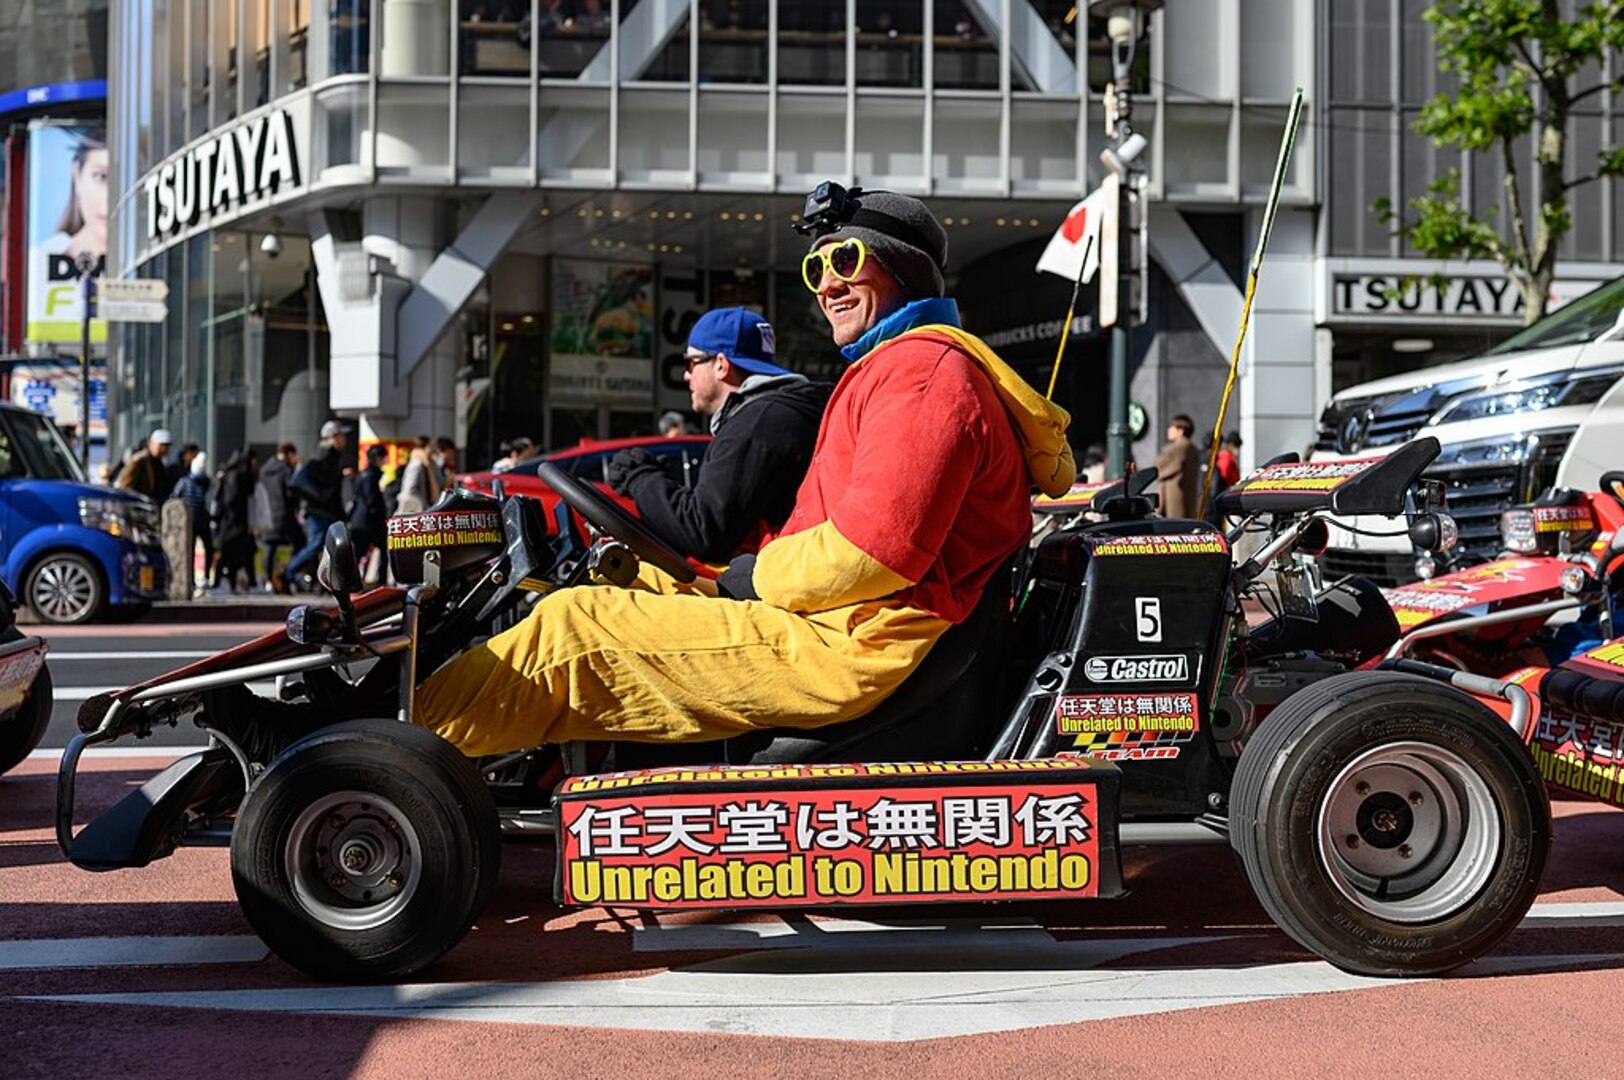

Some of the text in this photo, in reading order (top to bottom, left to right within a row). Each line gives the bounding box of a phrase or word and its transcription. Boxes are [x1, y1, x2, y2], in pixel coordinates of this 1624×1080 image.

[145, 110, 300, 240] TSUTAYA
[388, 533, 442, 549] Unrelated
[443, 532, 455, 546] to
[1096, 541, 1222, 555] Unrelated to Nintendo
[1140, 601, 1158, 637] 5
[1111, 657, 1184, 680] Castrol
[1060, 696, 1193, 716] 任天堂は無関係
[1060, 715, 1194, 733] Unrelated to Nintendo
[570, 768, 801, 792] Unrelated
[866, 760, 1079, 775] Nintendo
[1531, 741, 1616, 799] Unrelated
[567, 795, 1091, 857] 任天堂は無関係
[569, 848, 1092, 903] Unrelated to Nintendo
